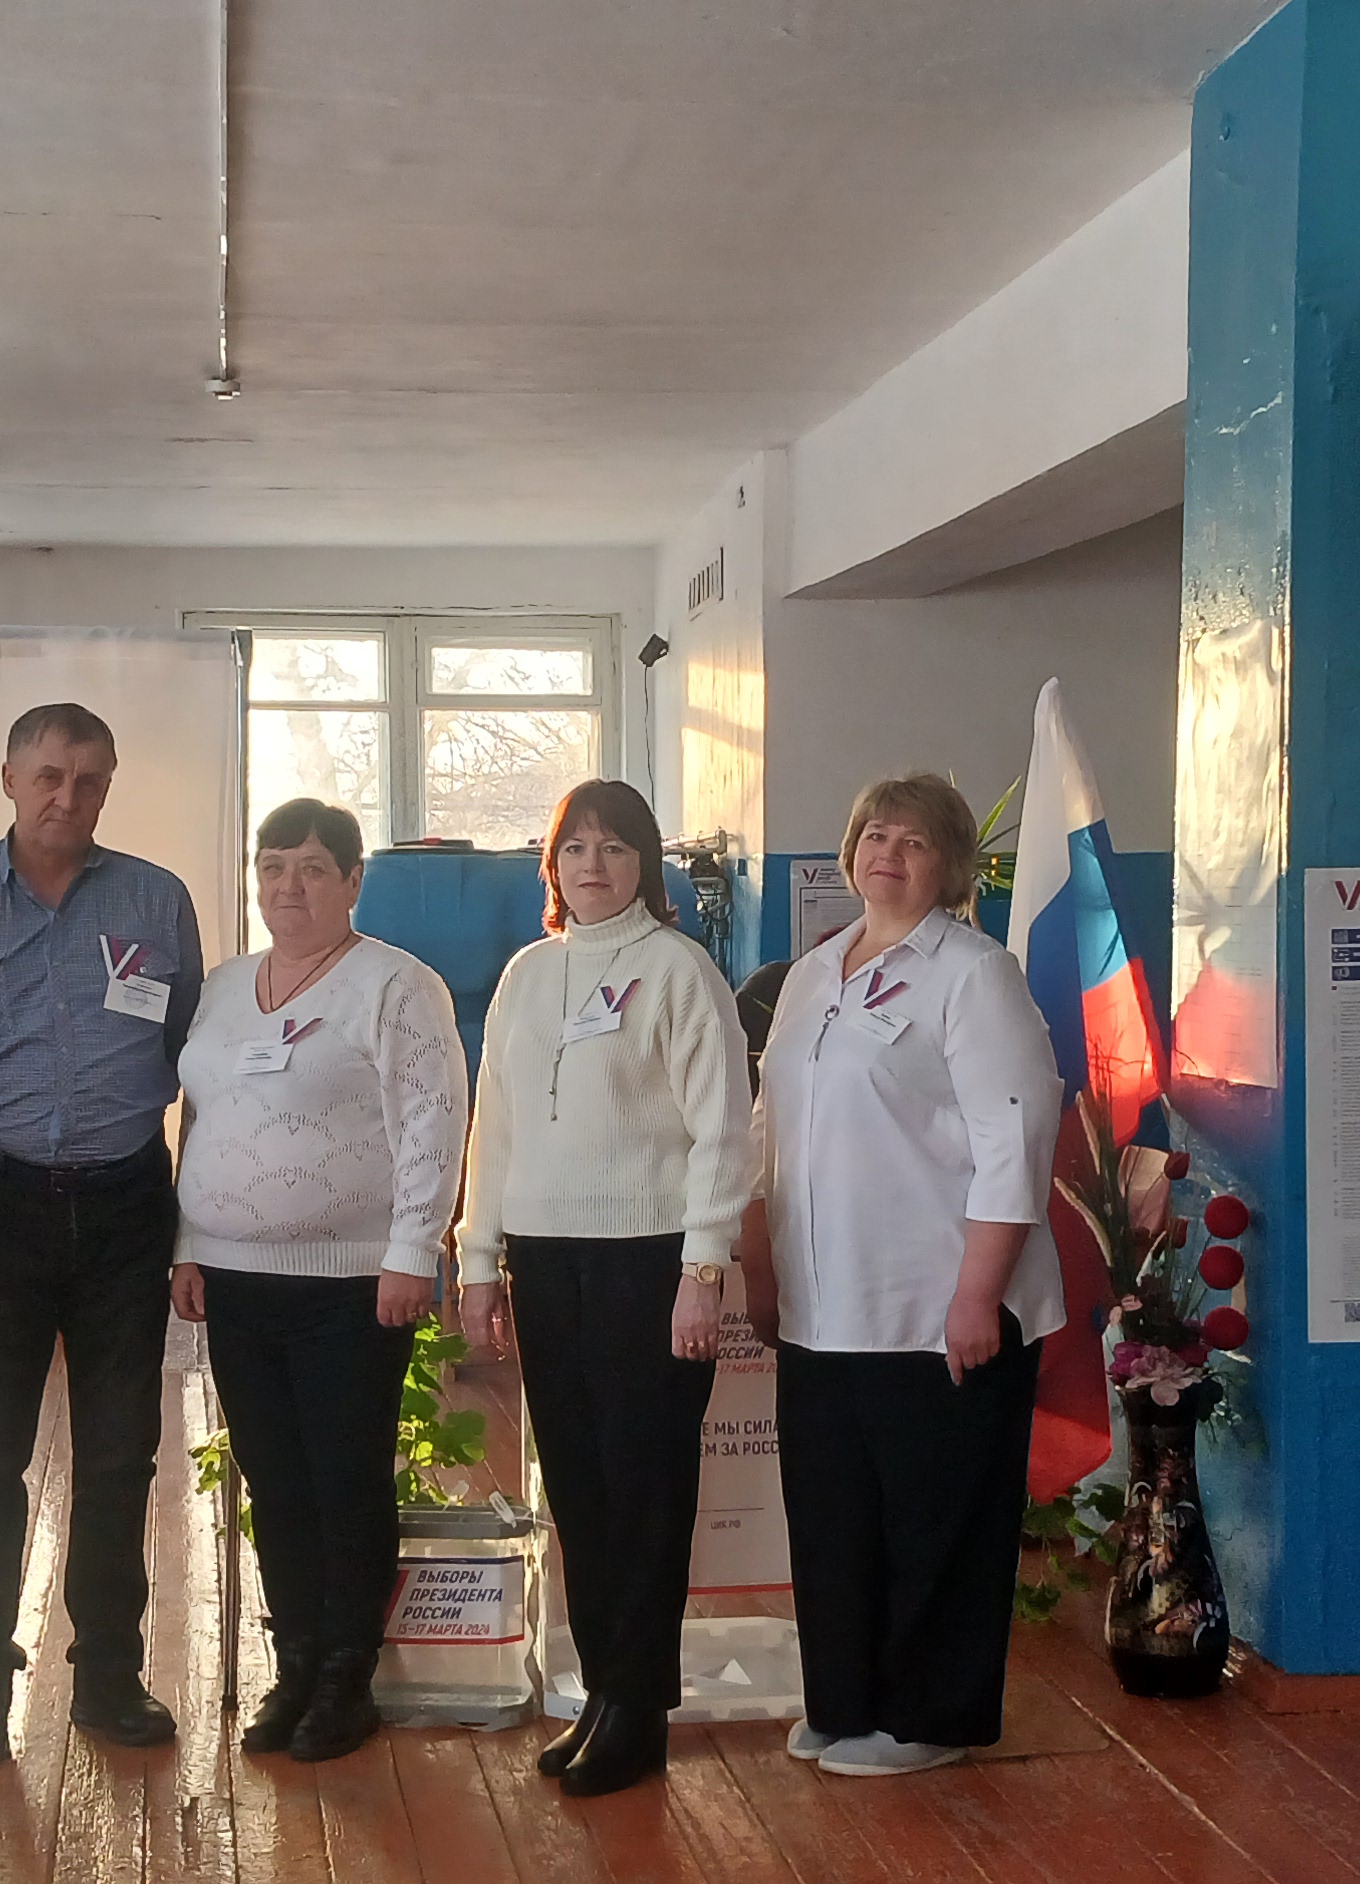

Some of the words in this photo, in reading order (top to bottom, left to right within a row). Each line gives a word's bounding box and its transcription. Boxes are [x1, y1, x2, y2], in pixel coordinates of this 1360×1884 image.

[717, 1346, 764, 1359] ОССИИ
[714, 1421, 739, 1435] МЫ
[721, 1442, 739, 1456] ЗА
[743, 1440, 779, 1455] РОСС
[417, 1569, 484, 1584] ВЫБОРЫ
[409, 1588, 503, 1603] ПРЕЗИДЕНТА
[402, 1606, 462, 1620] РОССИИ
[426, 1623, 462, 1636] МАРТА
[464, 1623, 490, 1636] 2024
